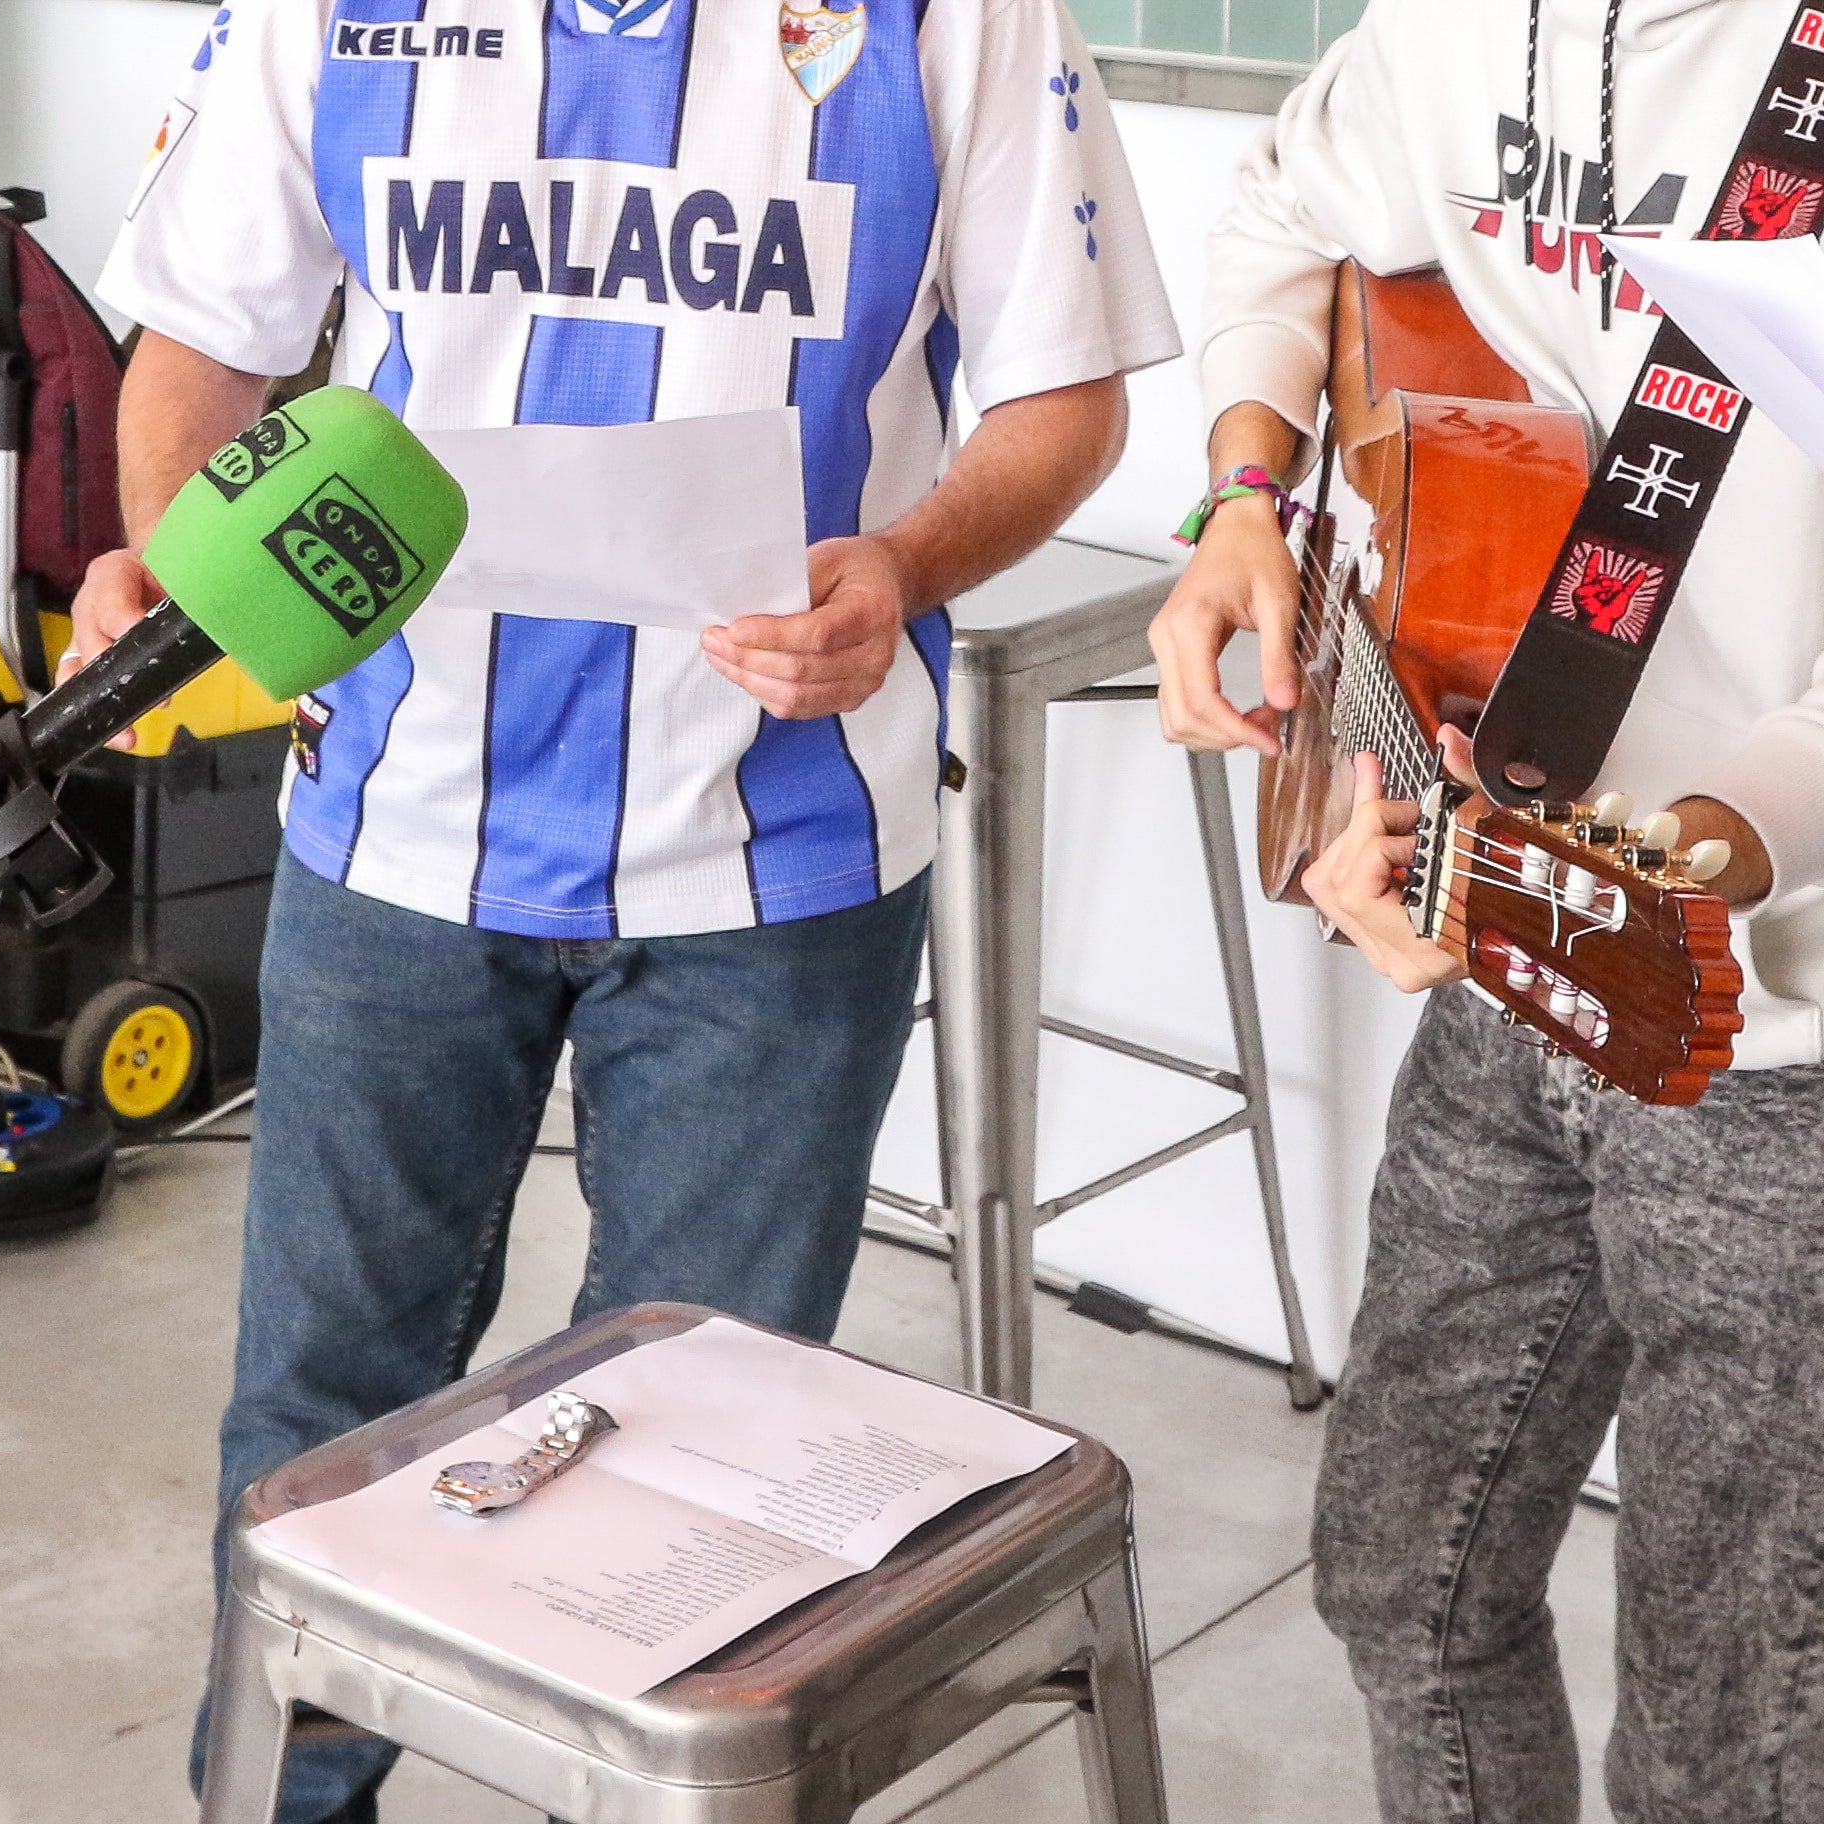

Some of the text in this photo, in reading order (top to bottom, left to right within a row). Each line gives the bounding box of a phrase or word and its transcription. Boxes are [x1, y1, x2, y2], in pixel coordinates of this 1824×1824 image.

[337, 25, 504, 59] KELME
[387, 179, 815, 318] MALAGA
[1641, 367, 1739, 429] ROCK
[296, 539, 368, 611] CERO
[326, 505, 393, 582] ONDA
